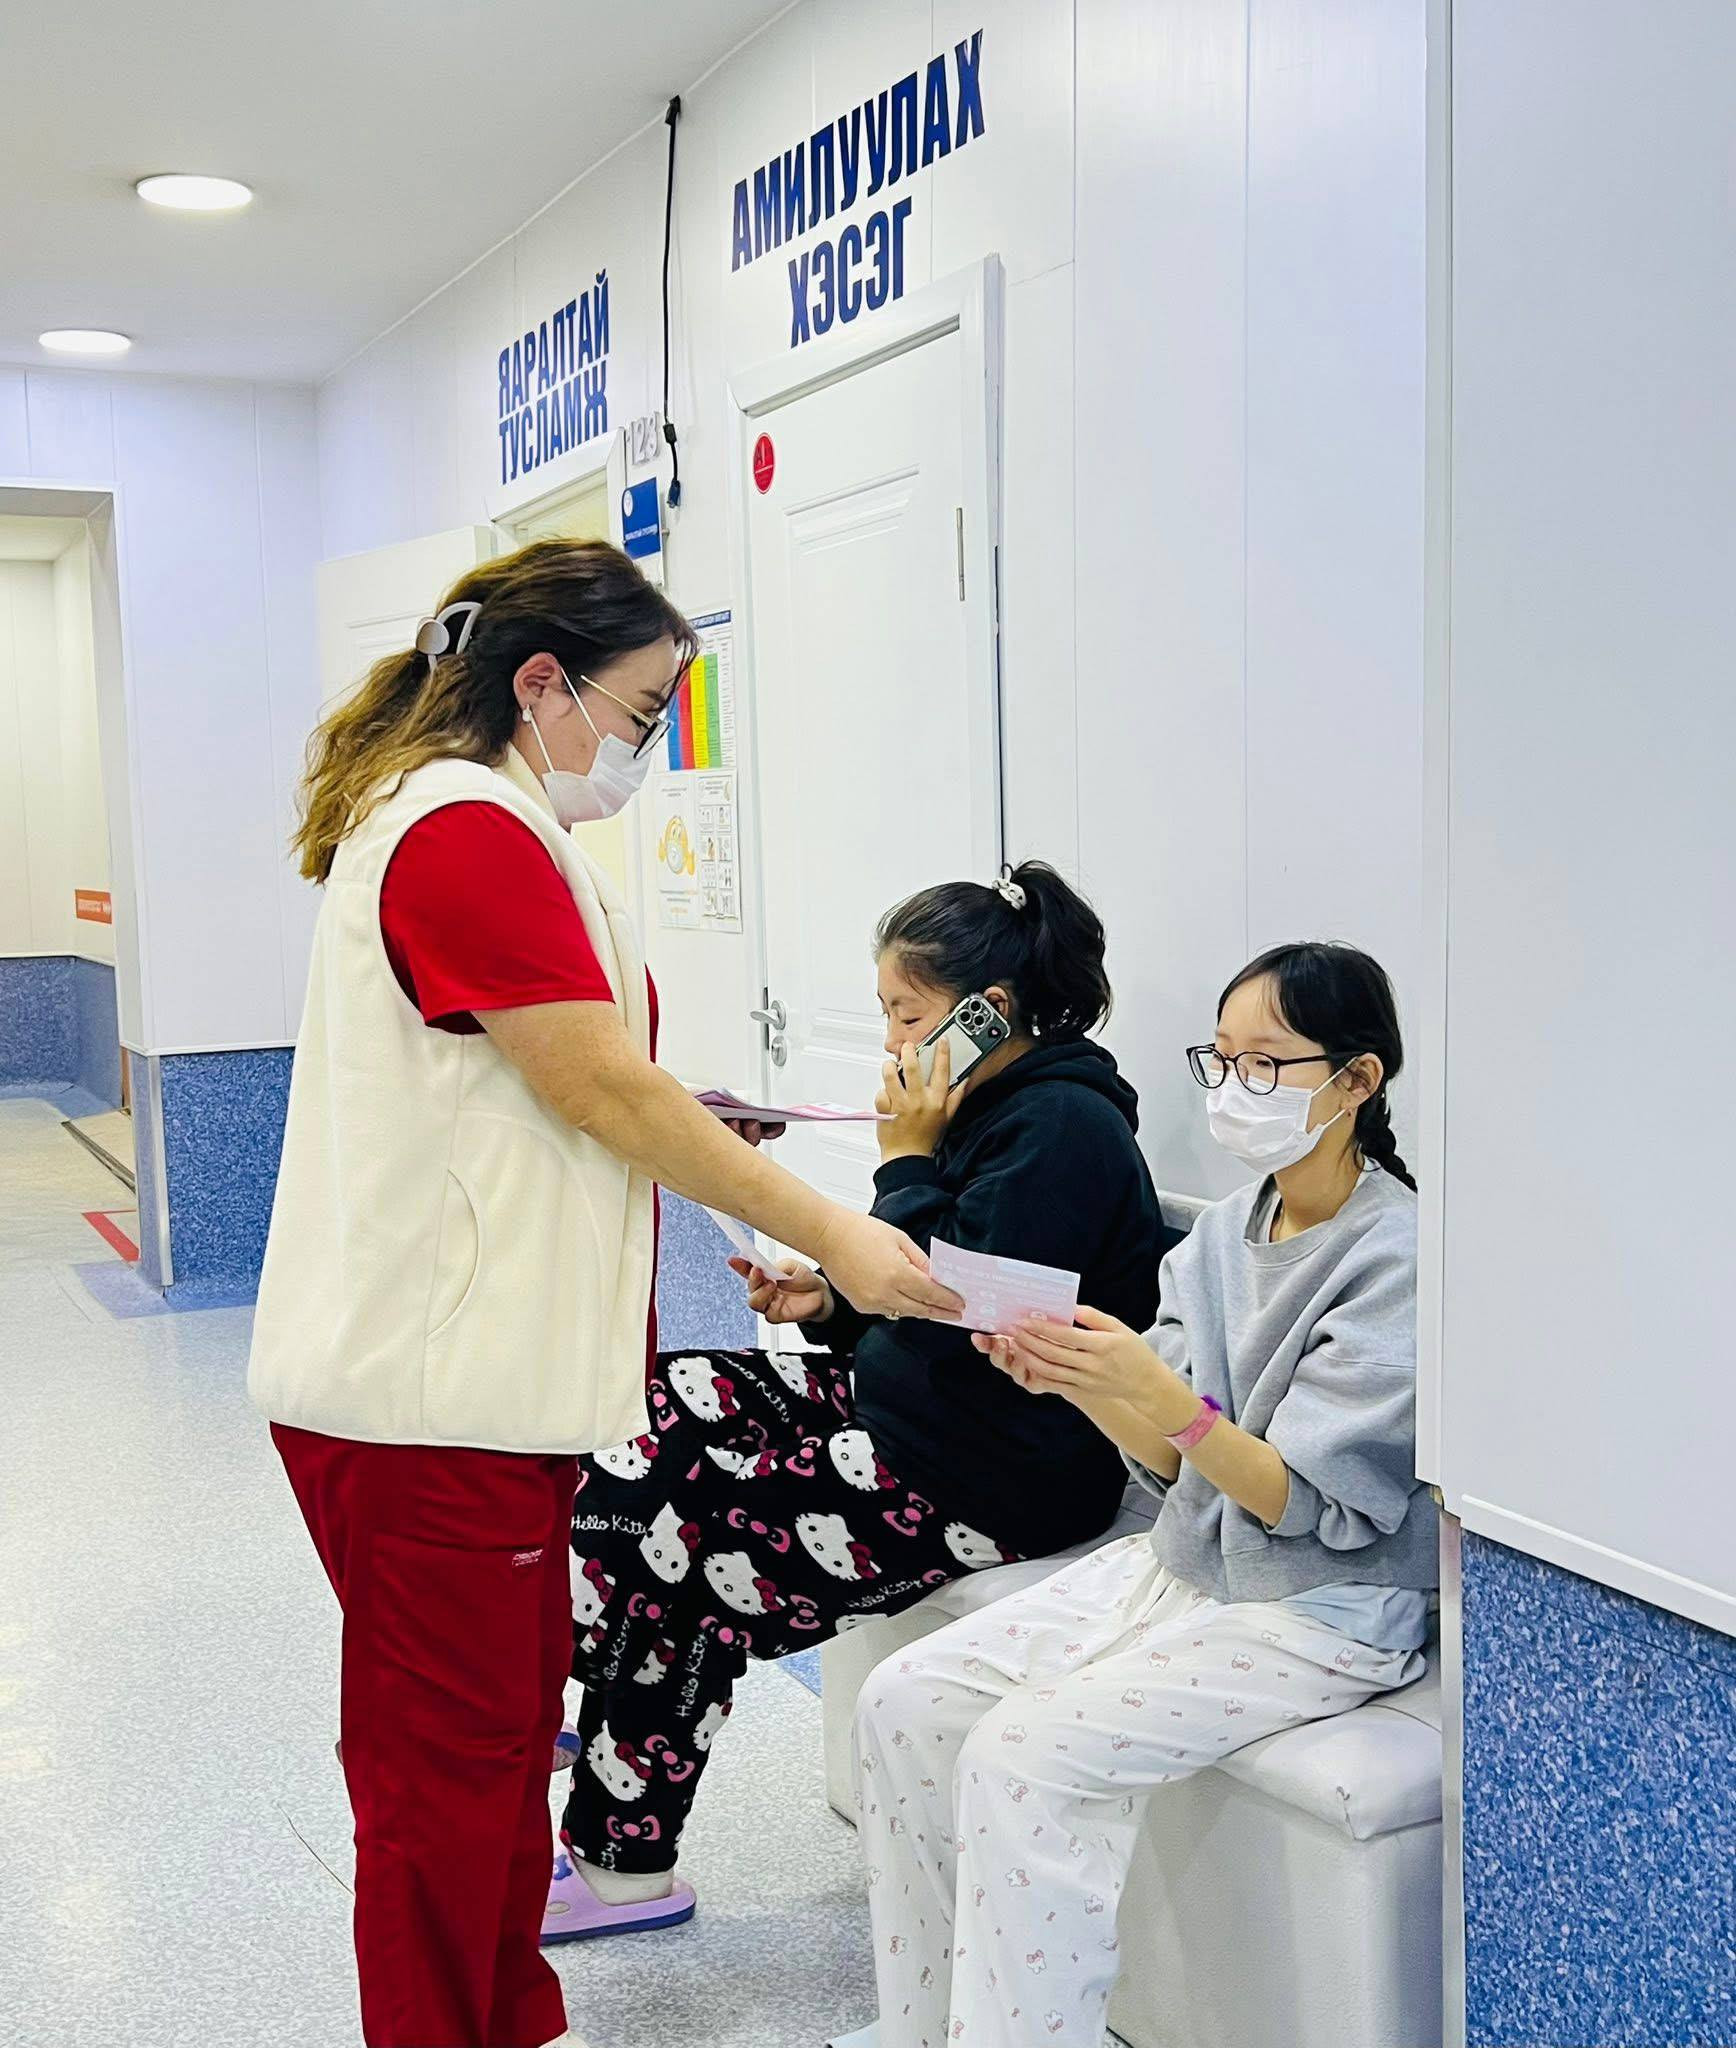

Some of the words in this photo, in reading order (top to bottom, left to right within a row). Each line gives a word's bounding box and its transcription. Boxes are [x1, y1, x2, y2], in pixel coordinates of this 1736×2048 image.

[732, 28, 985, 273] АМИЛУУЛАХ
[788, 196, 912, 349] ХЭСЭГ
[499, 268, 609, 419] ЯАРАЛТАЙ
[499, 360, 607, 484] ТУСЛАМЖ
[570, 1514, 609, 1531] Hello
[675, 1677, 700, 1717] Hello
[684, 1633, 707, 1675] Kitty
